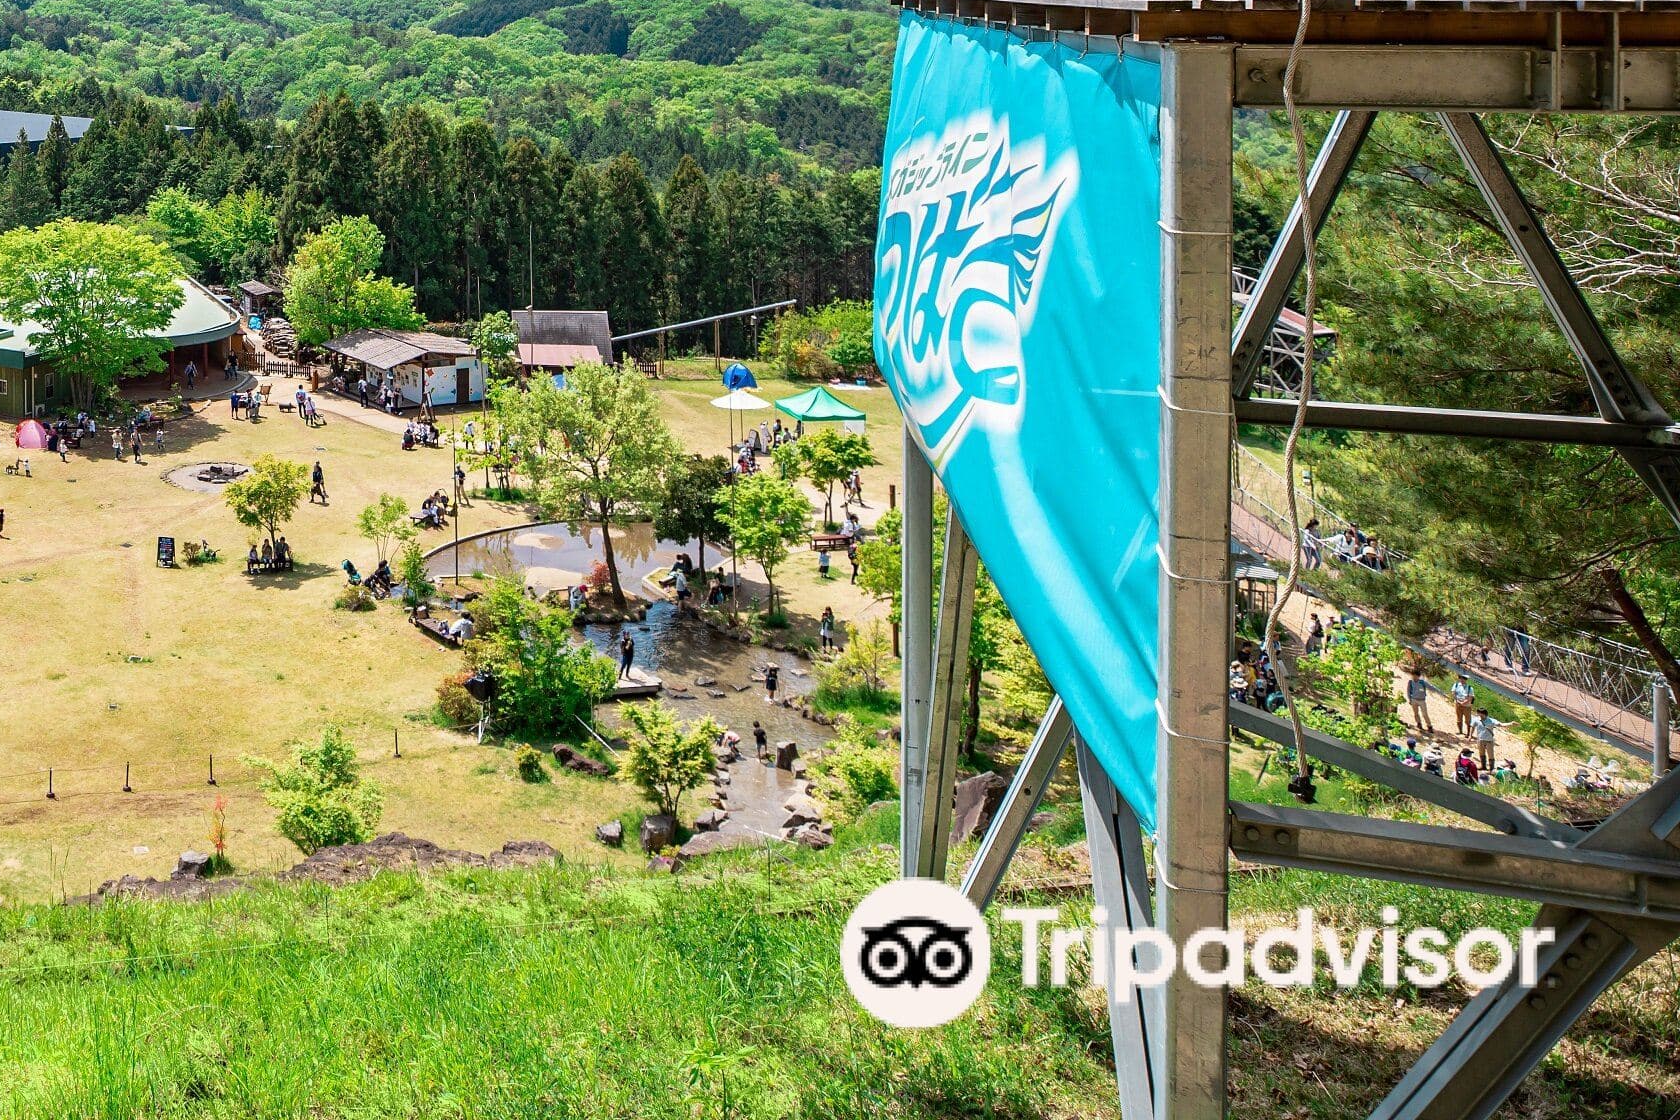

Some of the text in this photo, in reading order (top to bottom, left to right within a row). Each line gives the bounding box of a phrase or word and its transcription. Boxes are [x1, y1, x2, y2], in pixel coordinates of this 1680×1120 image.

[888, 132, 990, 200] メガジップライン
